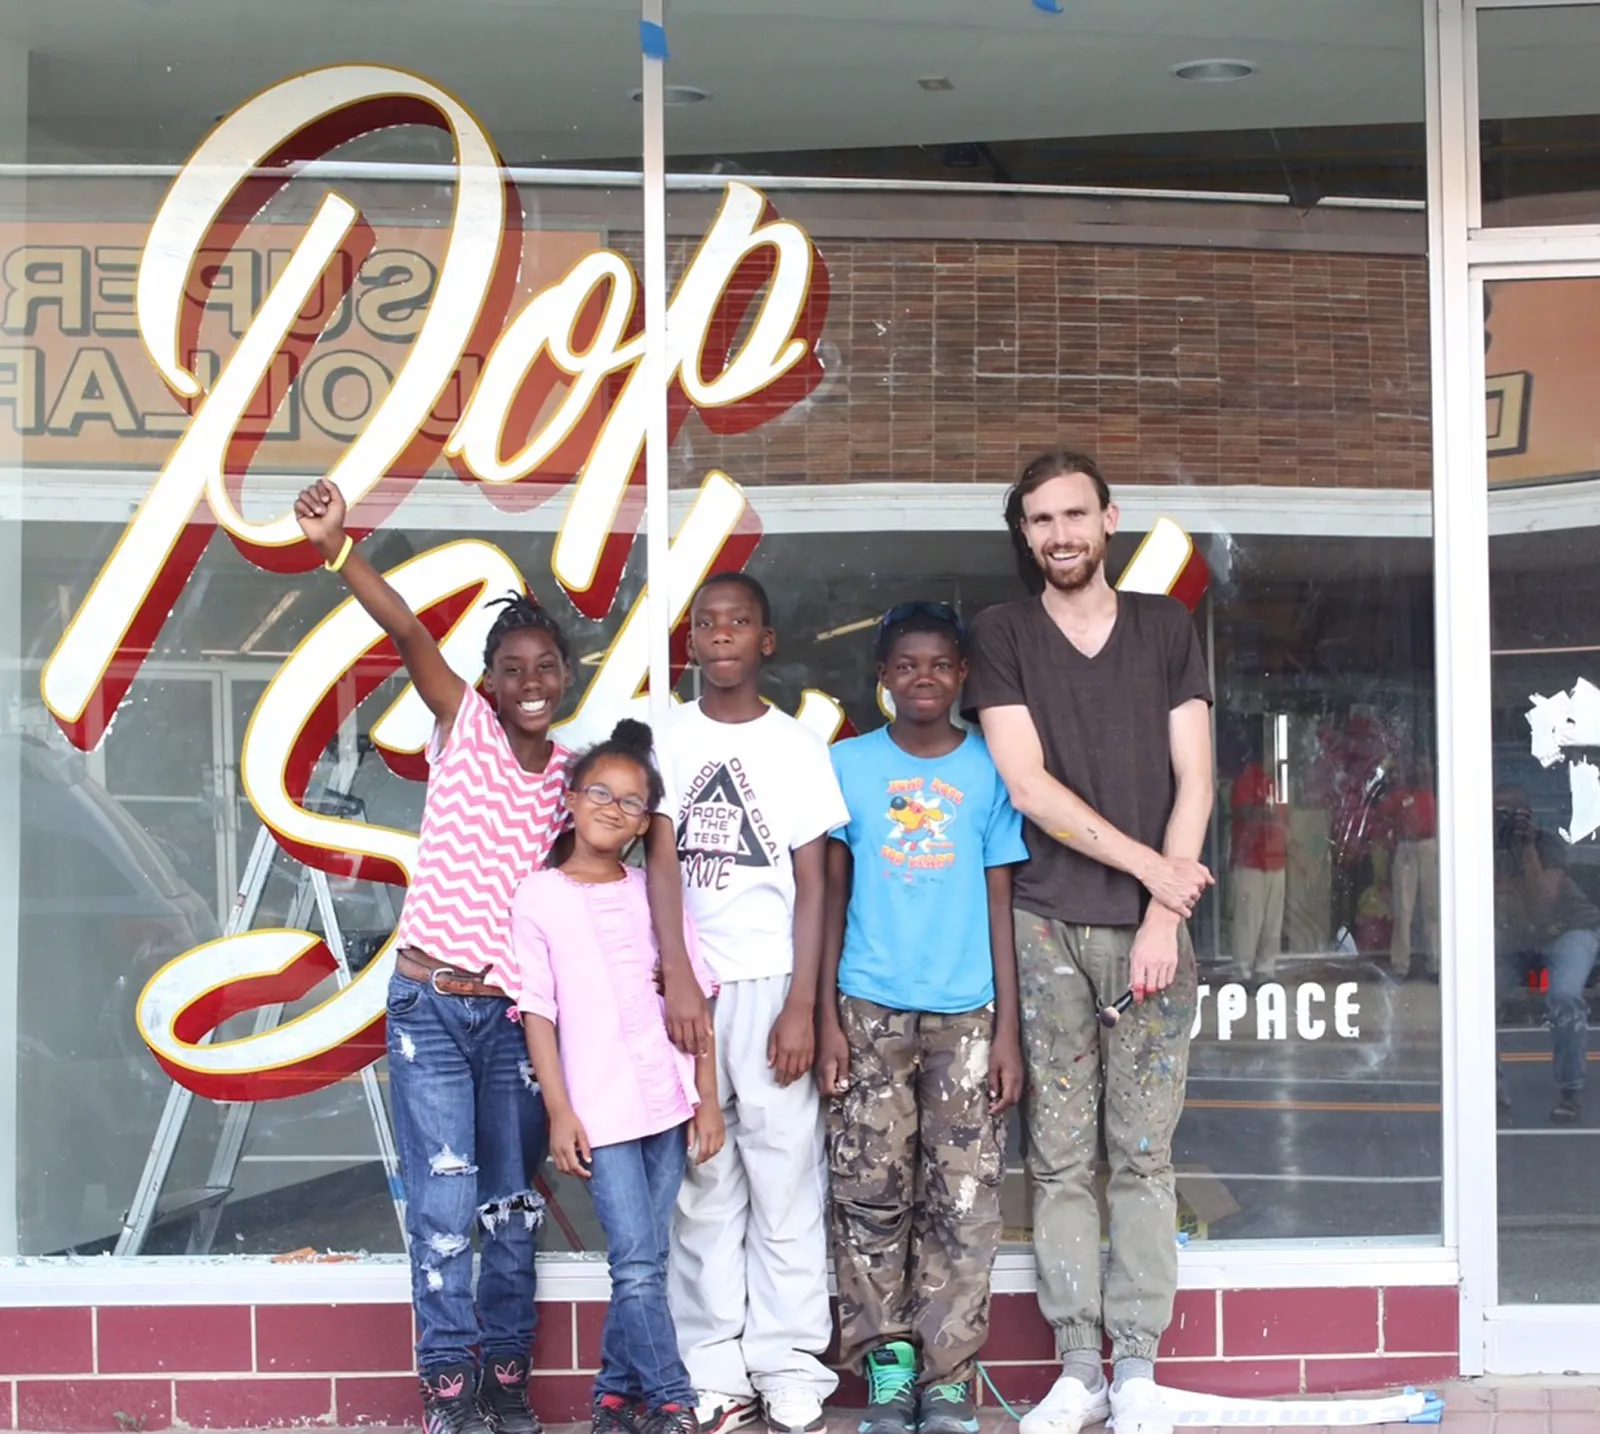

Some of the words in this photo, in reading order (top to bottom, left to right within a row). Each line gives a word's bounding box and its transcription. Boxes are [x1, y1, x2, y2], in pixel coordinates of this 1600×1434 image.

[42, 64, 830, 752] Pop
[679, 760, 721, 820] SCHOOL
[692, 807, 738, 820] ROCK
[700, 819, 729, 831] THE
[729, 757, 756, 802] ONE
[751, 808, 781, 867] GOAL
[694, 832, 731, 845] TEST
